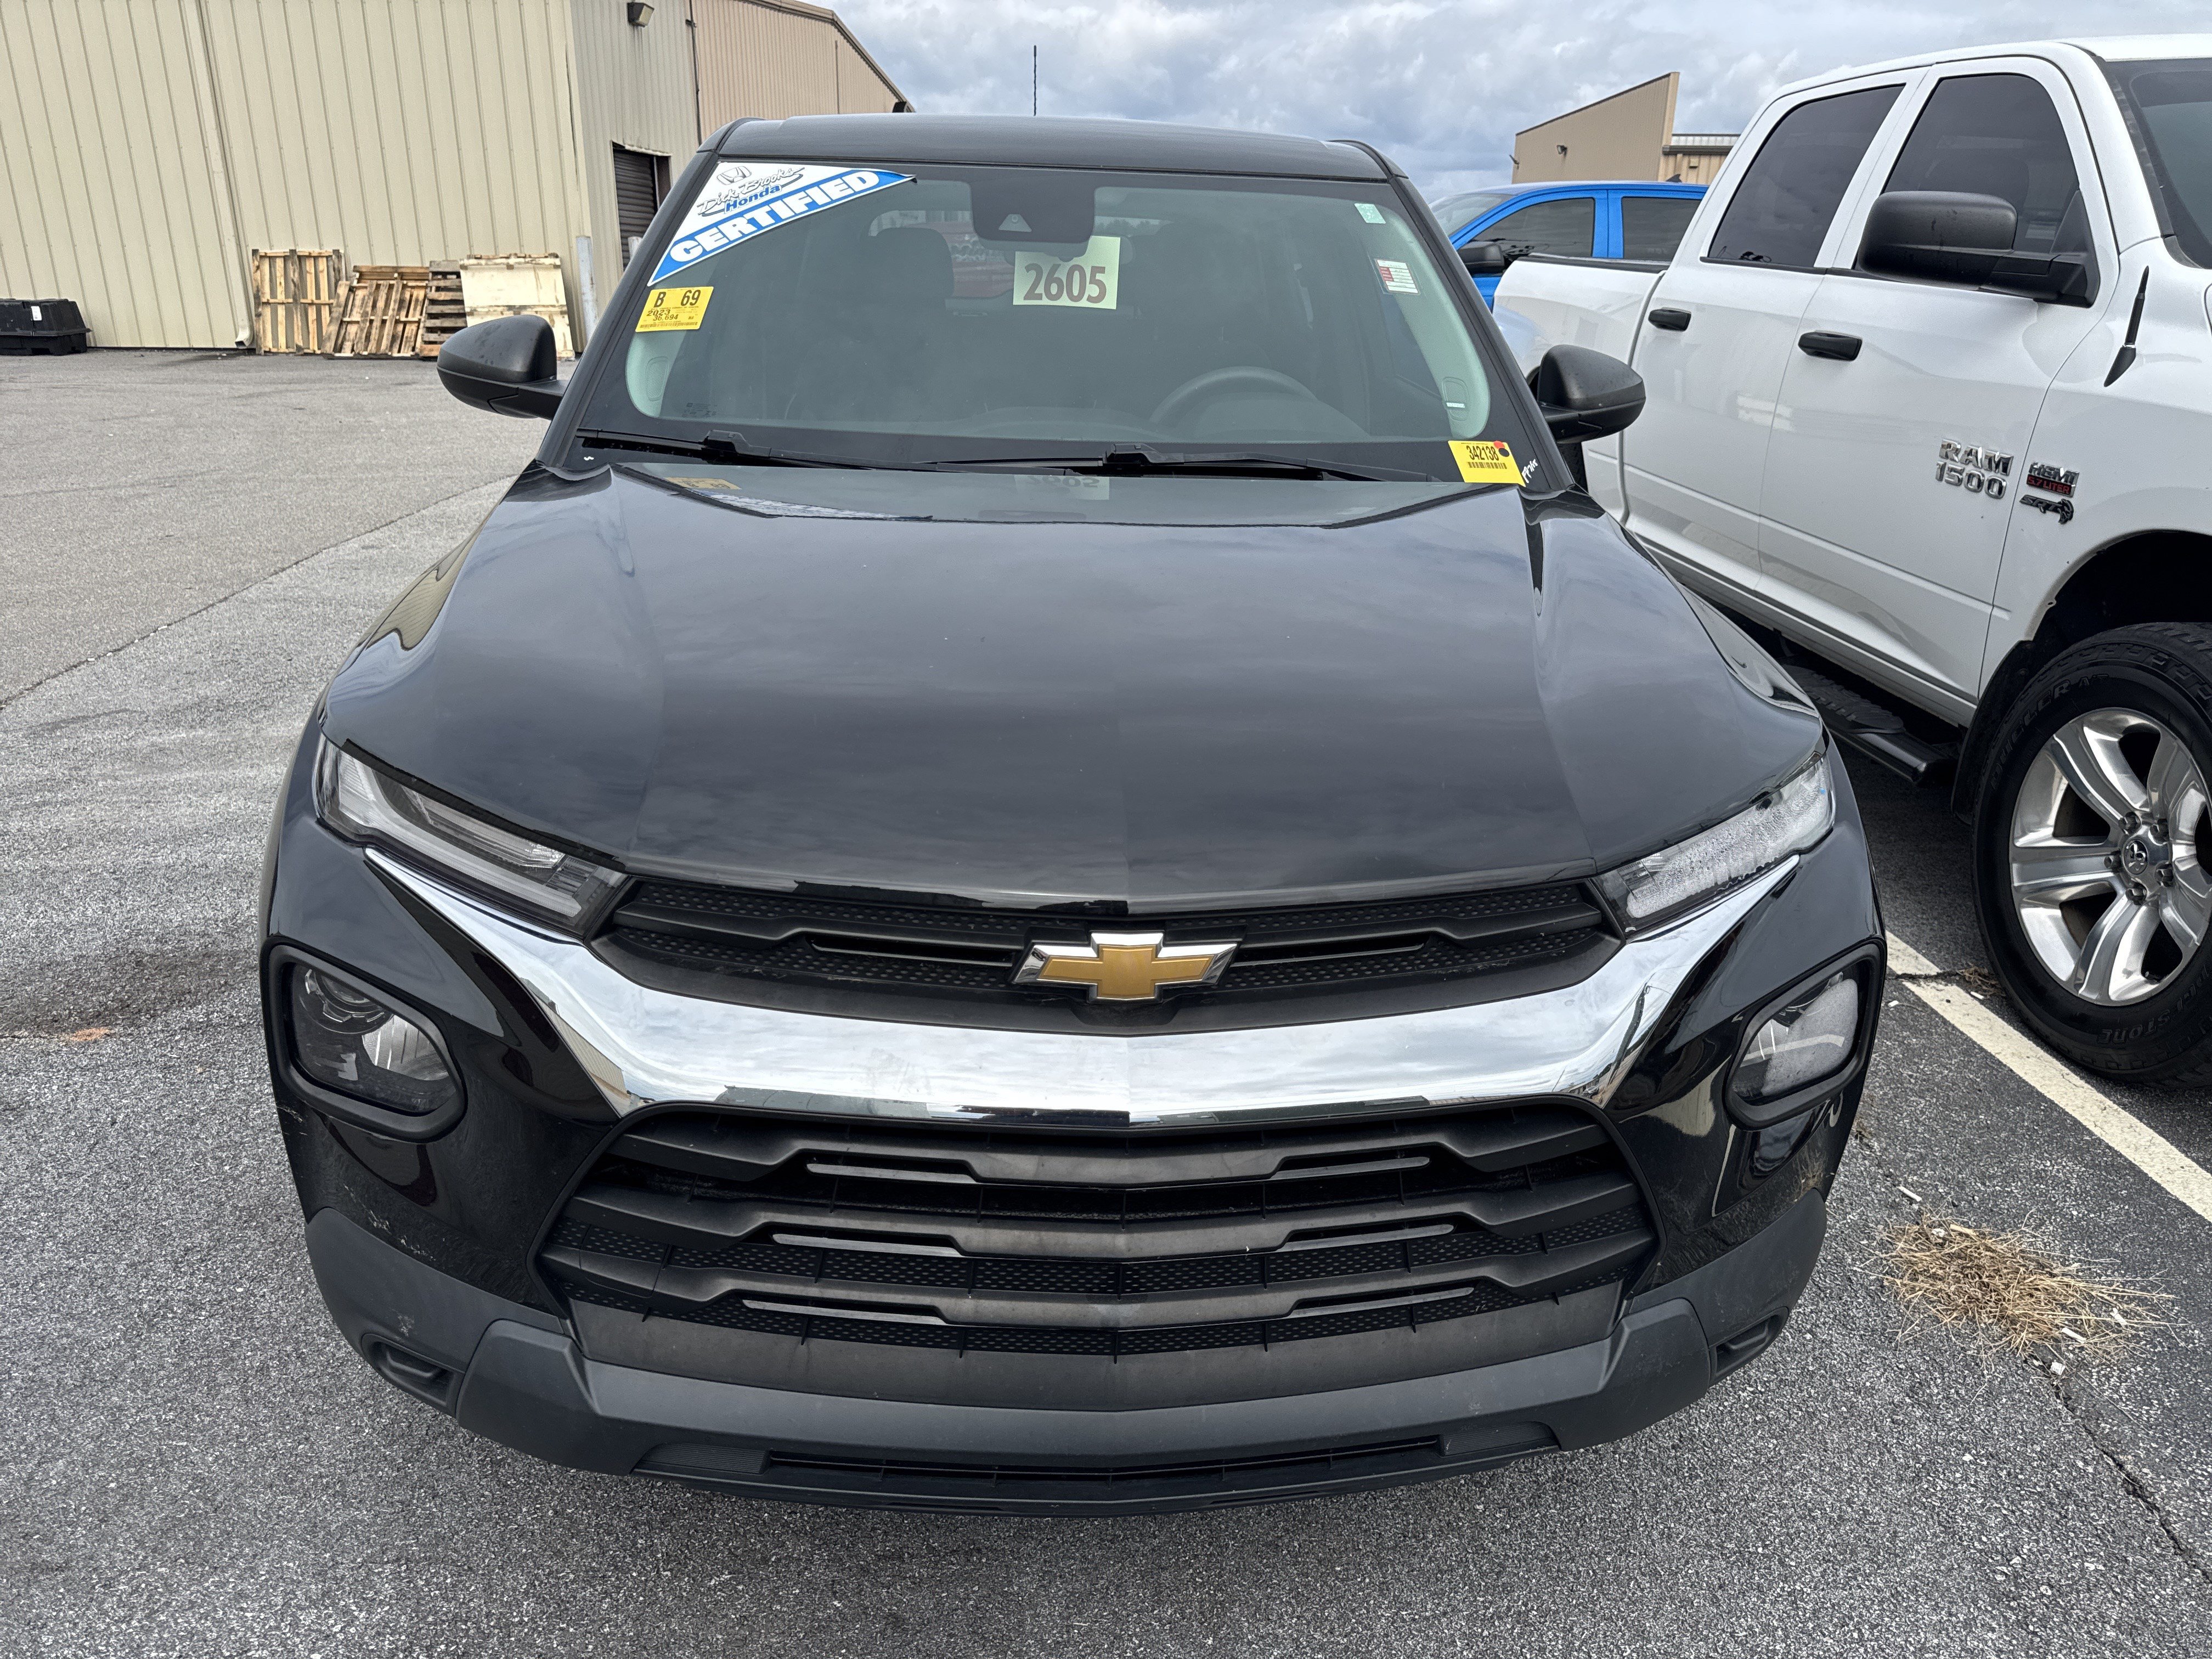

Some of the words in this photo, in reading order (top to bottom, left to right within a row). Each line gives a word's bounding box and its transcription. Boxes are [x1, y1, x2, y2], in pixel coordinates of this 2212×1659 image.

[697, 189, 740, 215] Dick
[738, 167, 805, 195] Brooks
[725, 184, 781, 213] Honda
[670, 171, 879, 262] CERTIFIED
[653, 291, 667, 308] B
[680, 290, 701, 307] 69
[1023, 263, 1107, 303] 2605
[1466, 445, 1499, 461] 342138
[1939, 438, 2014, 476] RAM
[1935, 461, 2008, 499] 1500
[2029, 462, 2080, 485] HEMI
[2042, 480, 2069, 494] LITER
